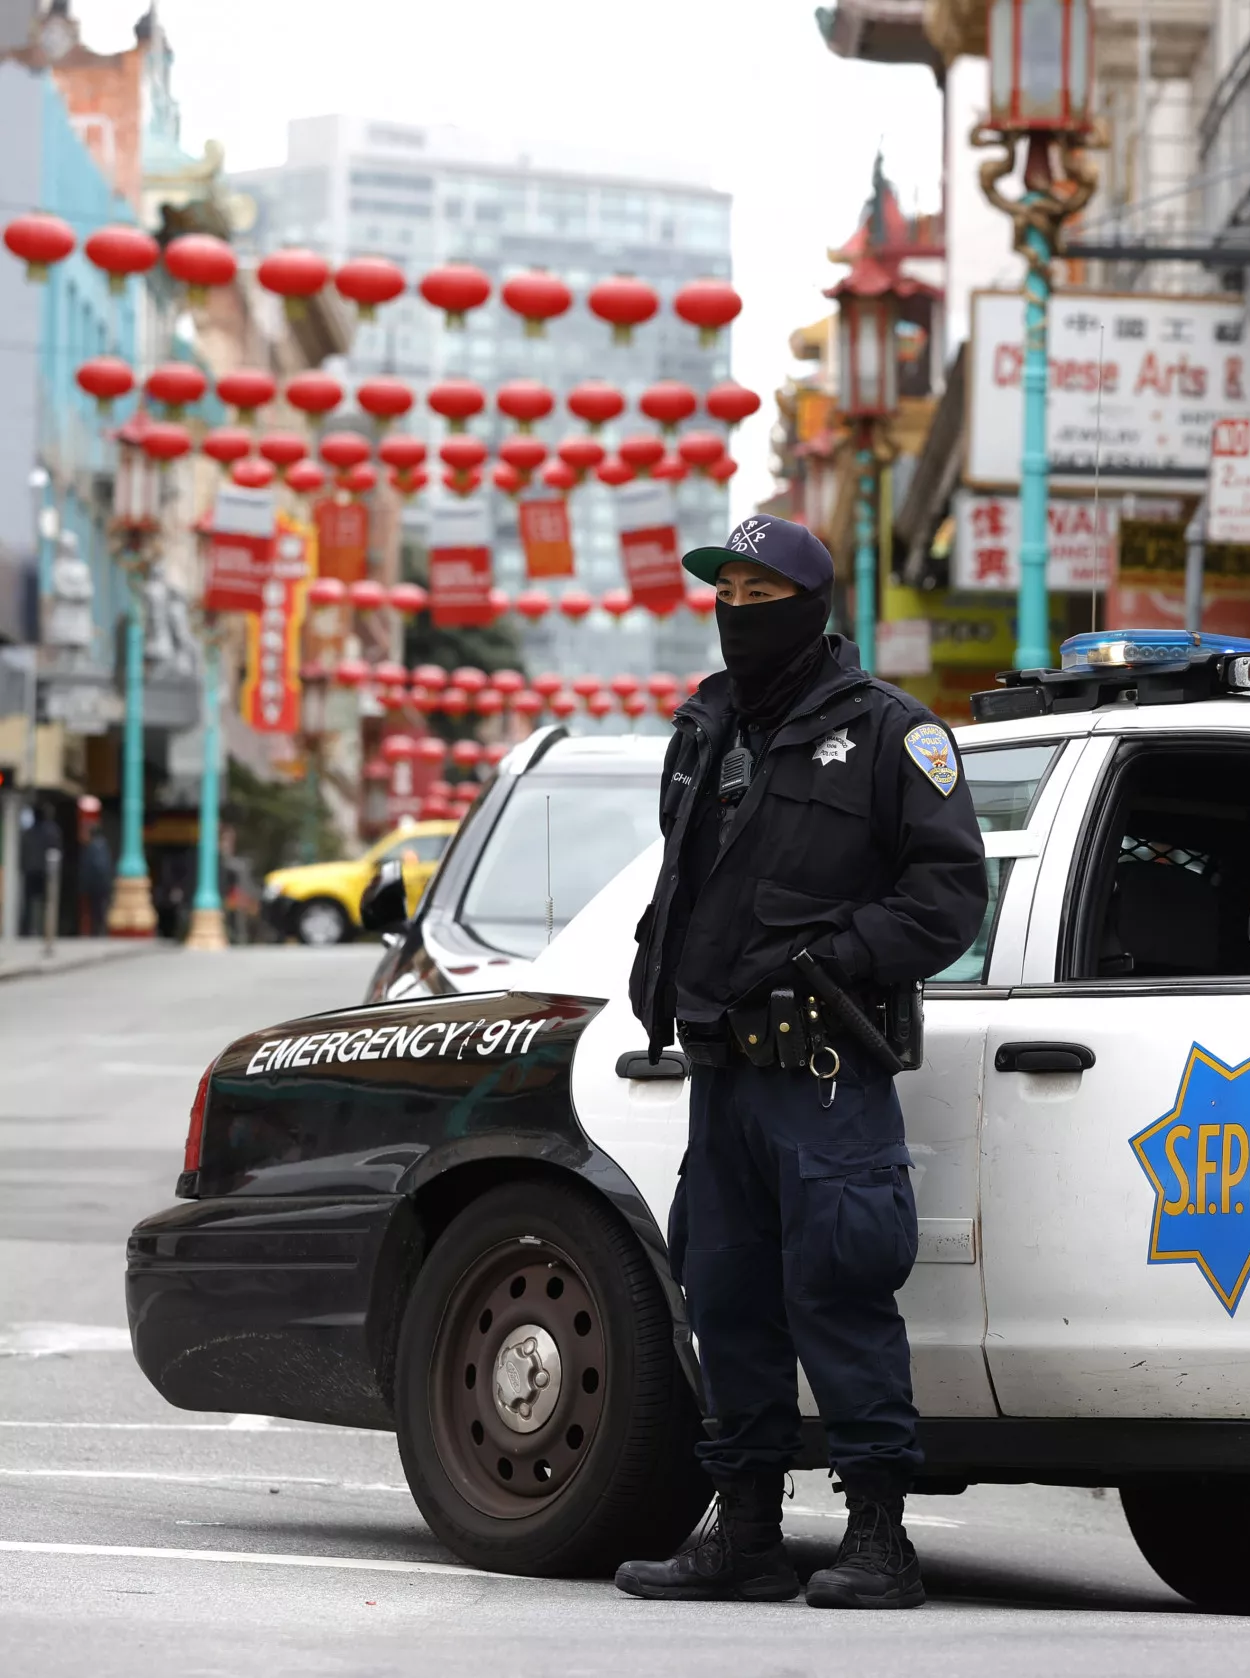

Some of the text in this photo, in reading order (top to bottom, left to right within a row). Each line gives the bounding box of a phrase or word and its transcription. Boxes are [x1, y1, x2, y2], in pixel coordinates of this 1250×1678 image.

[994, 343, 1118, 393] Chnese
[1133, 350, 1207, 397] Arts
[820, 749, 838, 757] POLICE
[921, 737, 943, 745] POLICE
[246, 1022, 473, 1076] EMERGENCY
[476, 1019, 546, 1055] 911
